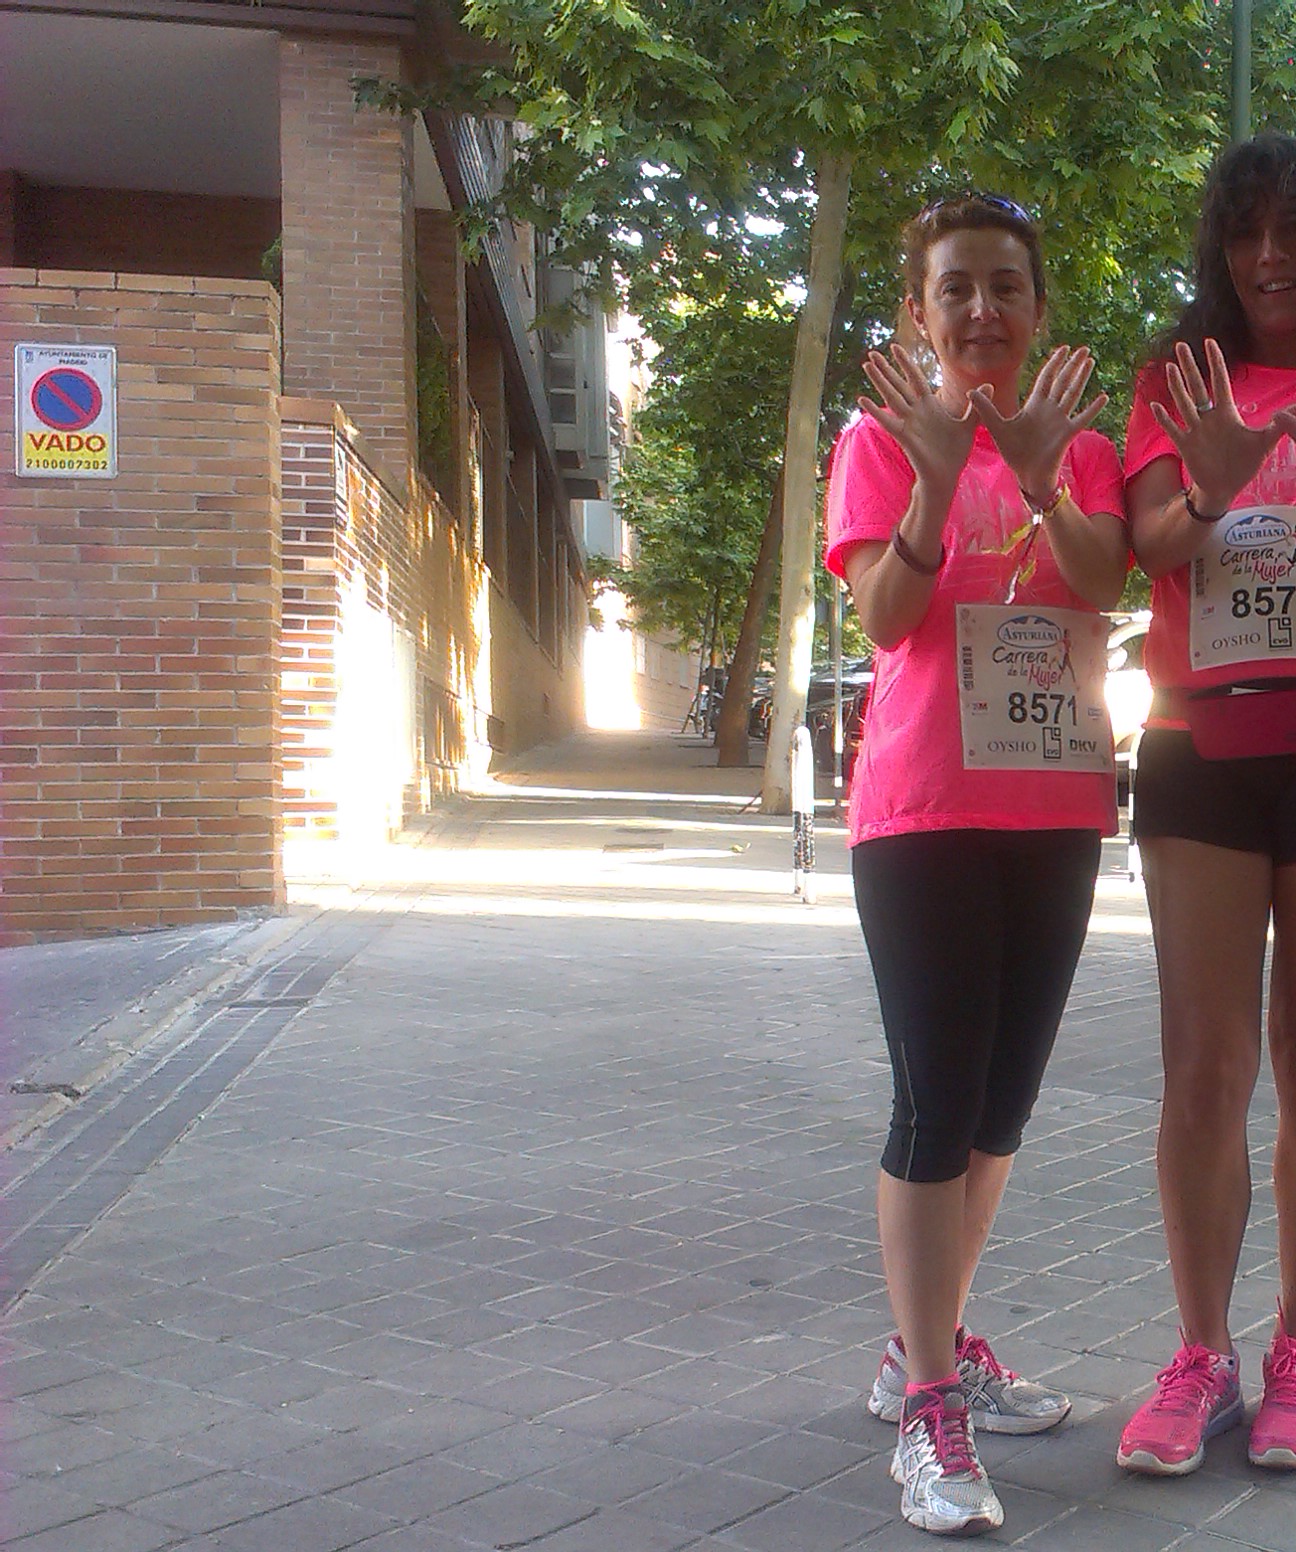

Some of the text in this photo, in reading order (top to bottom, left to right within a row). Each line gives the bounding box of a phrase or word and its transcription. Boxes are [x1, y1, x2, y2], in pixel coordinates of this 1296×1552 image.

[28, 433, 106, 453] VADO
[26, 459, 108, 470] 2100007302
[1231, 527, 1287, 543] ASTURIANA
[1220, 547, 1275, 568] Carrera
[1232, 557, 1295, 585] de la Mujer
[1002, 627, 1059, 643] ASTURIANA
[1211, 632, 1262, 650] OYSHO
[992, 646, 1049, 665] Carrera
[1007, 662, 1064, 691] de la Mujer
[1008, 691, 1078, 726] 8571
[987, 740, 1037, 753] OYSHO
[1069, 738, 1098, 753] DKV
